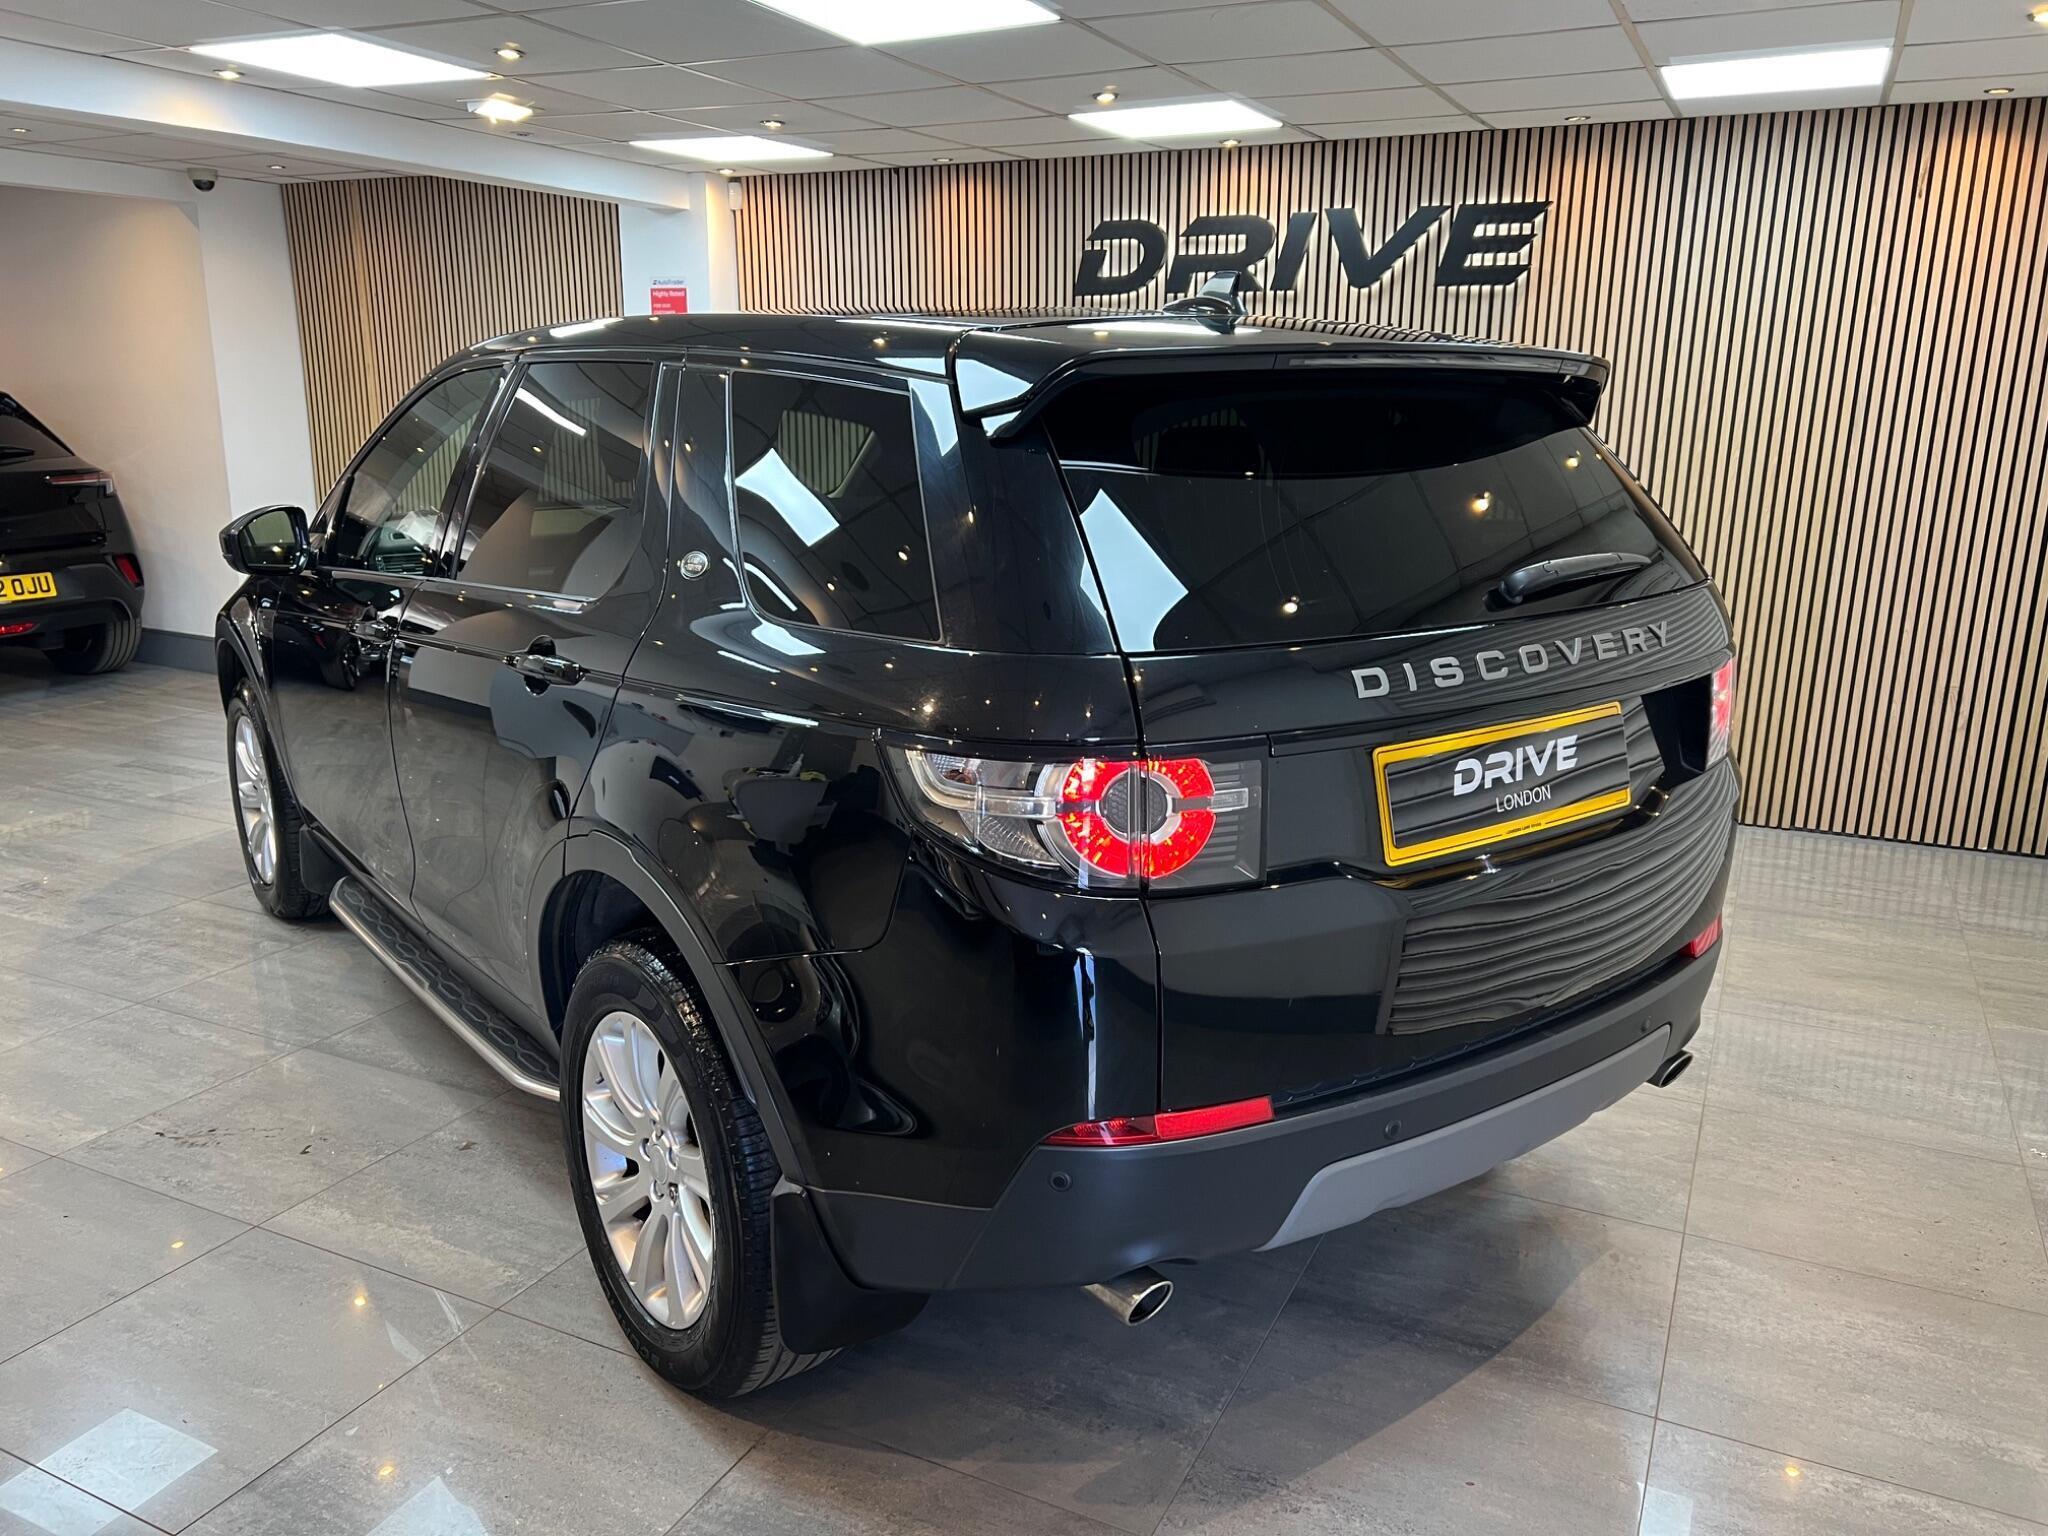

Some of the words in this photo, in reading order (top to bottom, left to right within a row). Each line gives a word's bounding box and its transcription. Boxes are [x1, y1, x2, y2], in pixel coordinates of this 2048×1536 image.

[1074, 201, 1554, 296] DRIVE
[11, 576, 51, 595] OJU
[1351, 620, 1670, 699] DISCOVERY
[1453, 734, 1579, 797] DRIVE
[1496, 785, 1552, 813] LONDON
